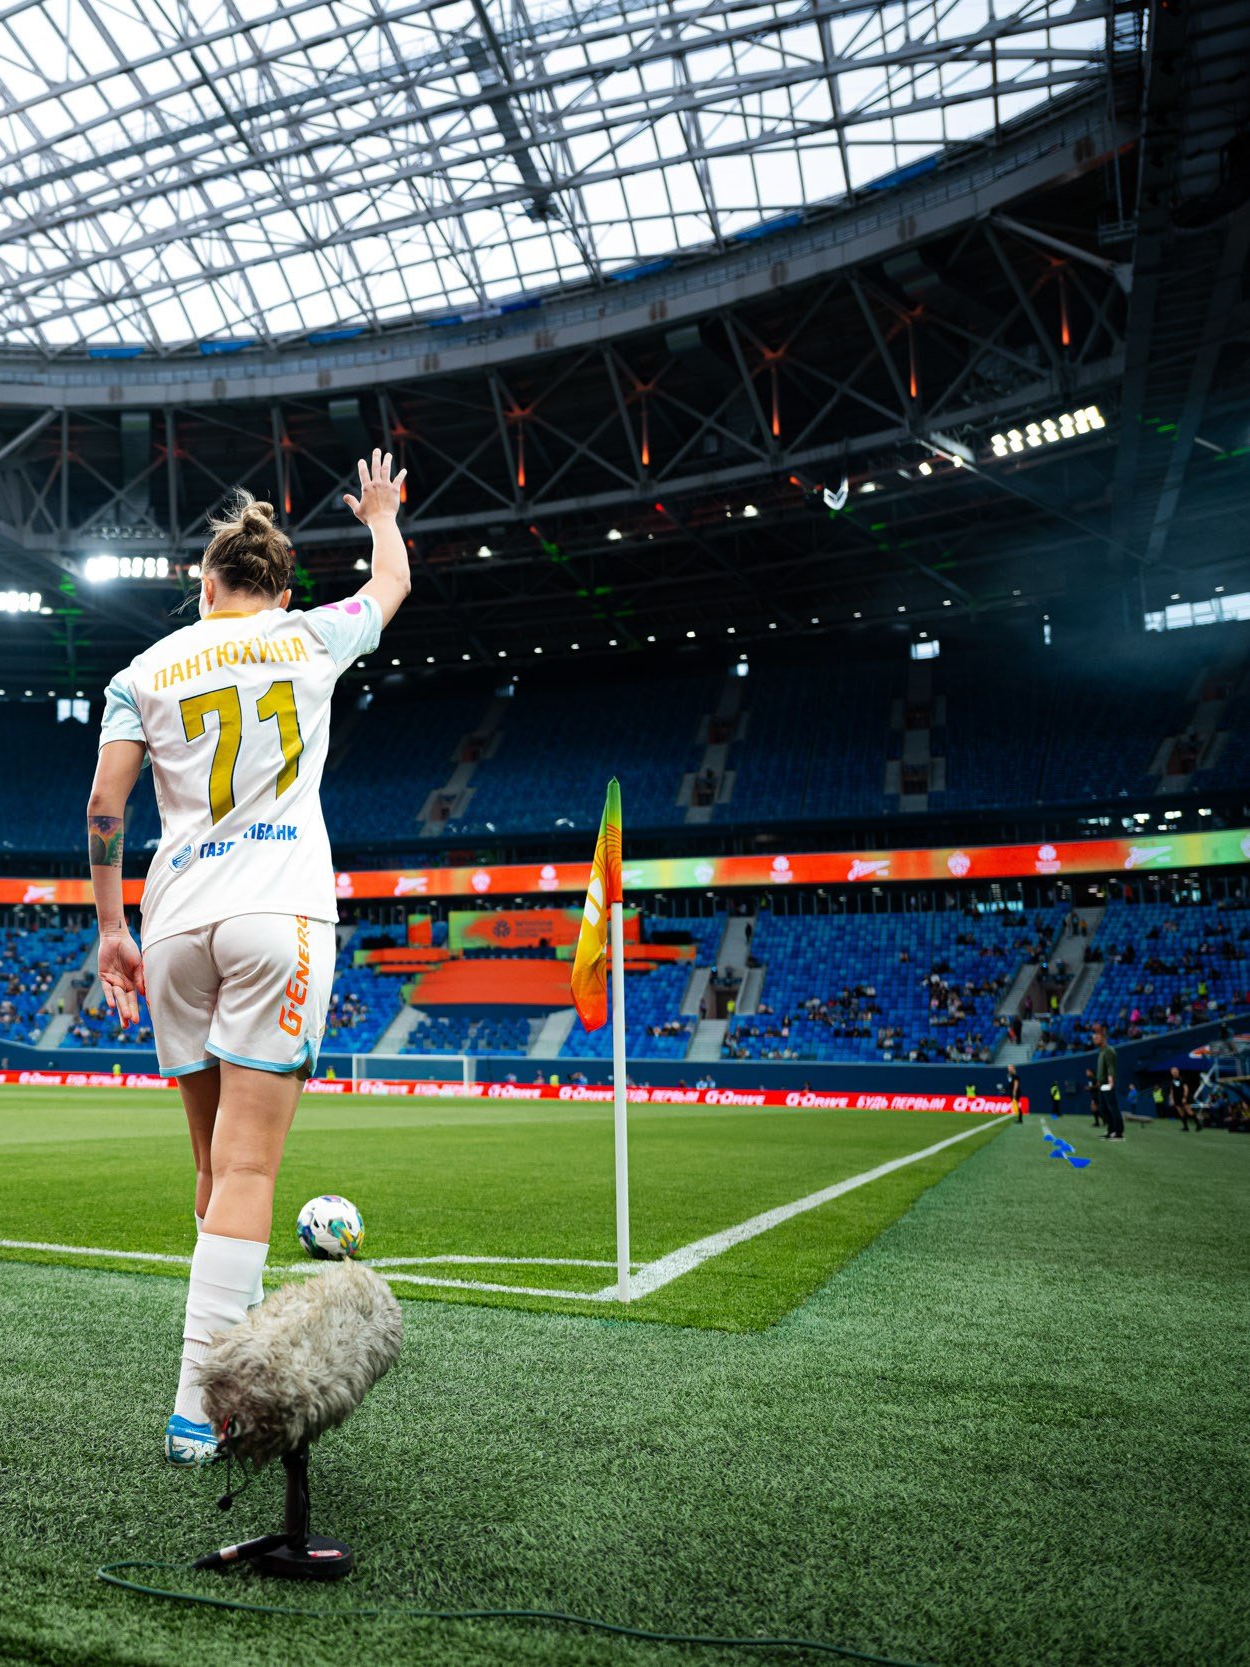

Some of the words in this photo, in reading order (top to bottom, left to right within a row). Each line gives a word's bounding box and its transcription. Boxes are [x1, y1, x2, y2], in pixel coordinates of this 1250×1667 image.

[153, 636, 310, 692] ПАНТЮХИНА
[179, 680, 305, 826] 71
[199, 822, 298, 859] ГАЗМБАНК
[953, 1097, 1021, 1114] G-DRIV
